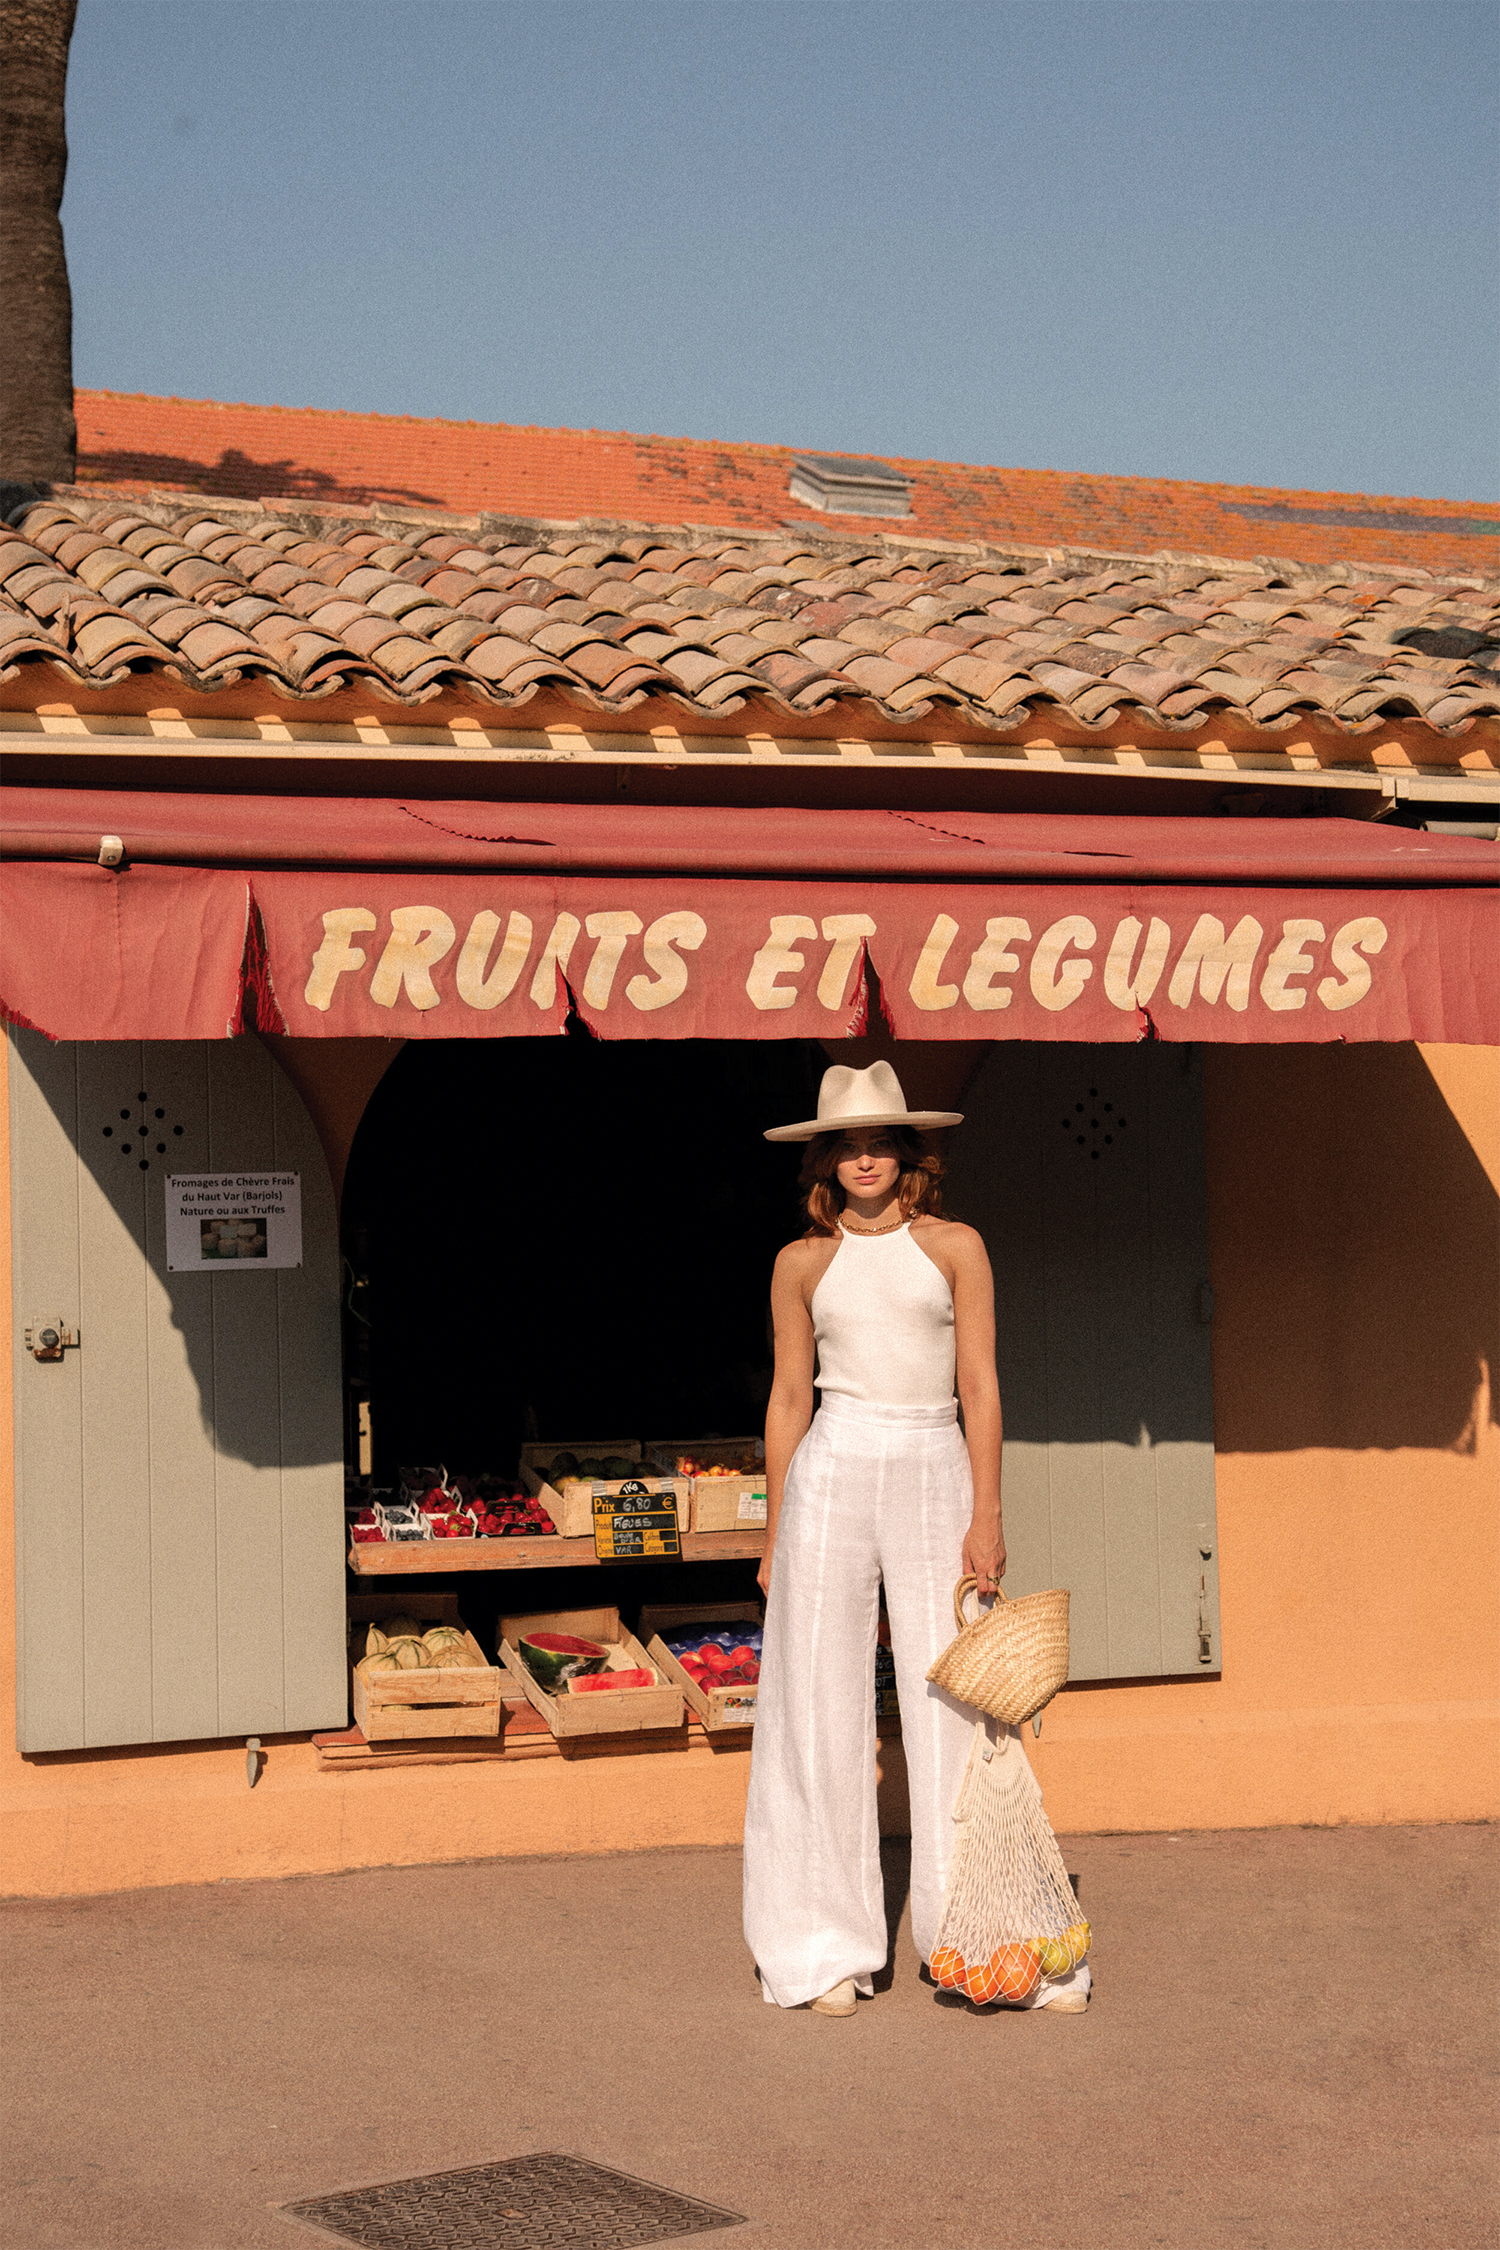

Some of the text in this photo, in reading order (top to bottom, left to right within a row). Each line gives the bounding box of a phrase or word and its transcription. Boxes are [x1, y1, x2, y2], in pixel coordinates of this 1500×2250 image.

[305, 906, 1388, 1012] FRUITS ET LEGUMES
[171, 1177, 295, 1188] Fromages de Chèvre Frais
[182, 1191, 282, 1202] du Haut Var (Barjols)
[180, 1207, 214, 1216] Nature
[251, 1205, 285, 1215] Truffes
[593, 1496, 674, 1513] Prix 6,80 €
[615, 1546, 632, 1555] VAR
